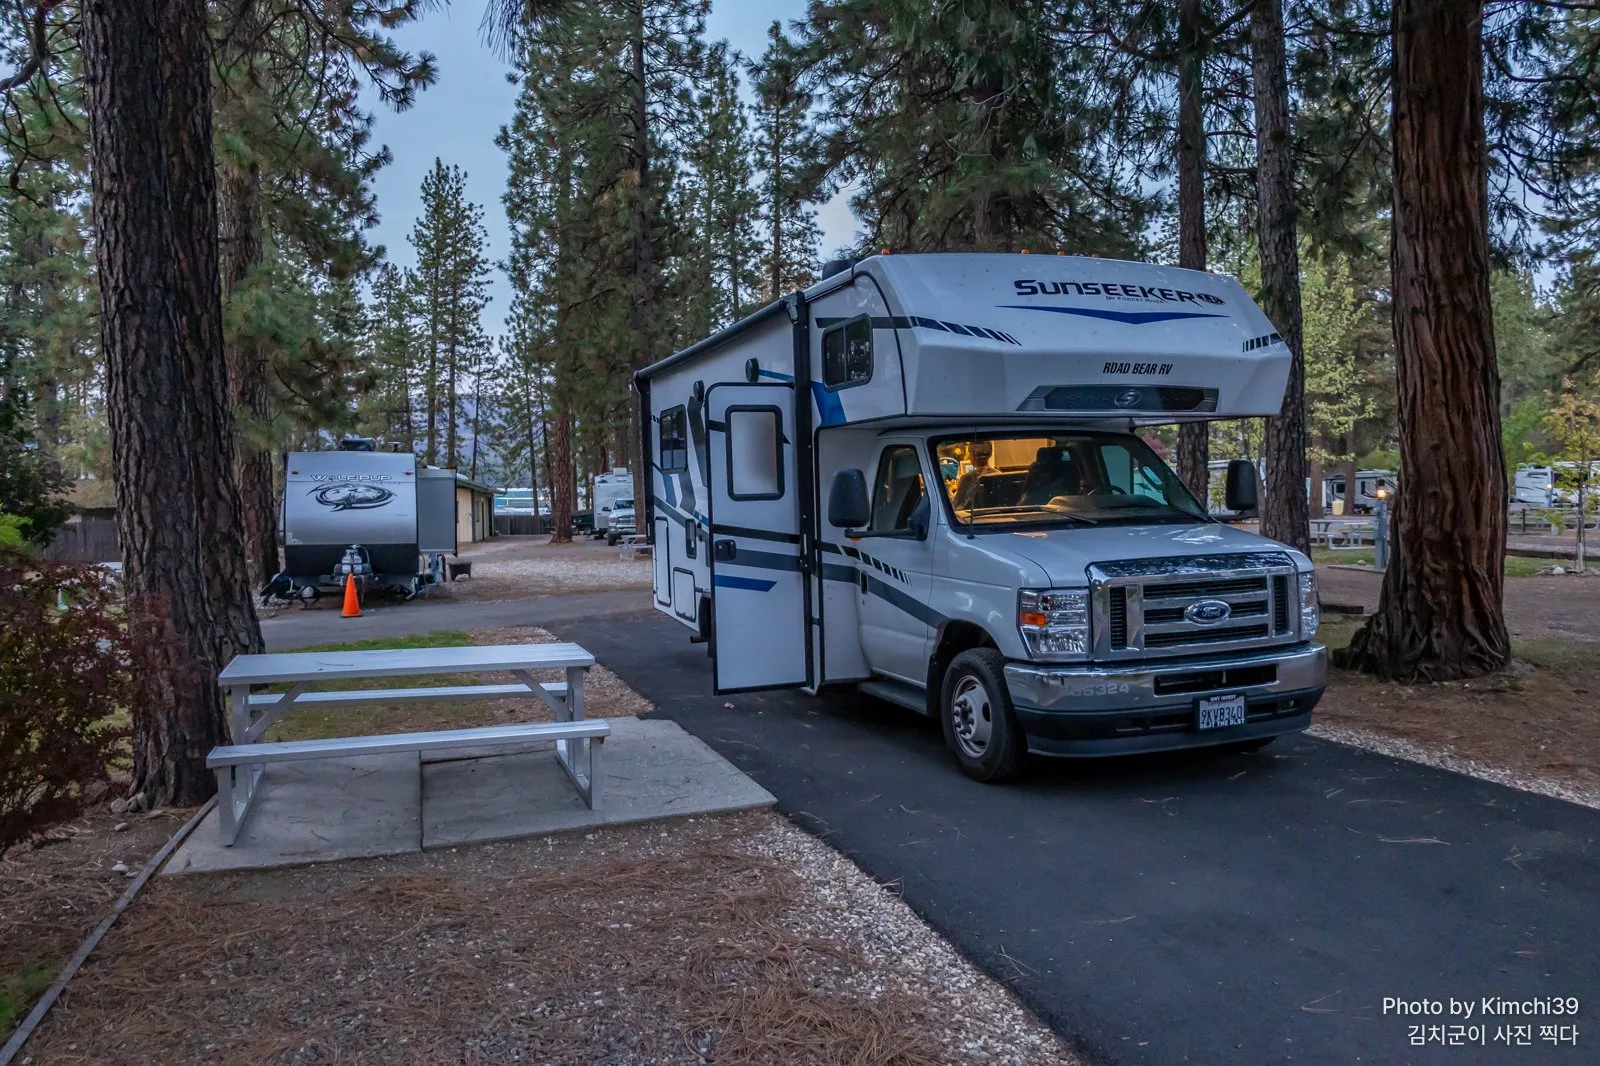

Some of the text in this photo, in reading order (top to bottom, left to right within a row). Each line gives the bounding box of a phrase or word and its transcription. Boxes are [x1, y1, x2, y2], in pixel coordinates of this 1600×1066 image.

[1103, 362, 1173, 375] ROAD BEAR RV
[1201, 606, 1221, 617] Ford
